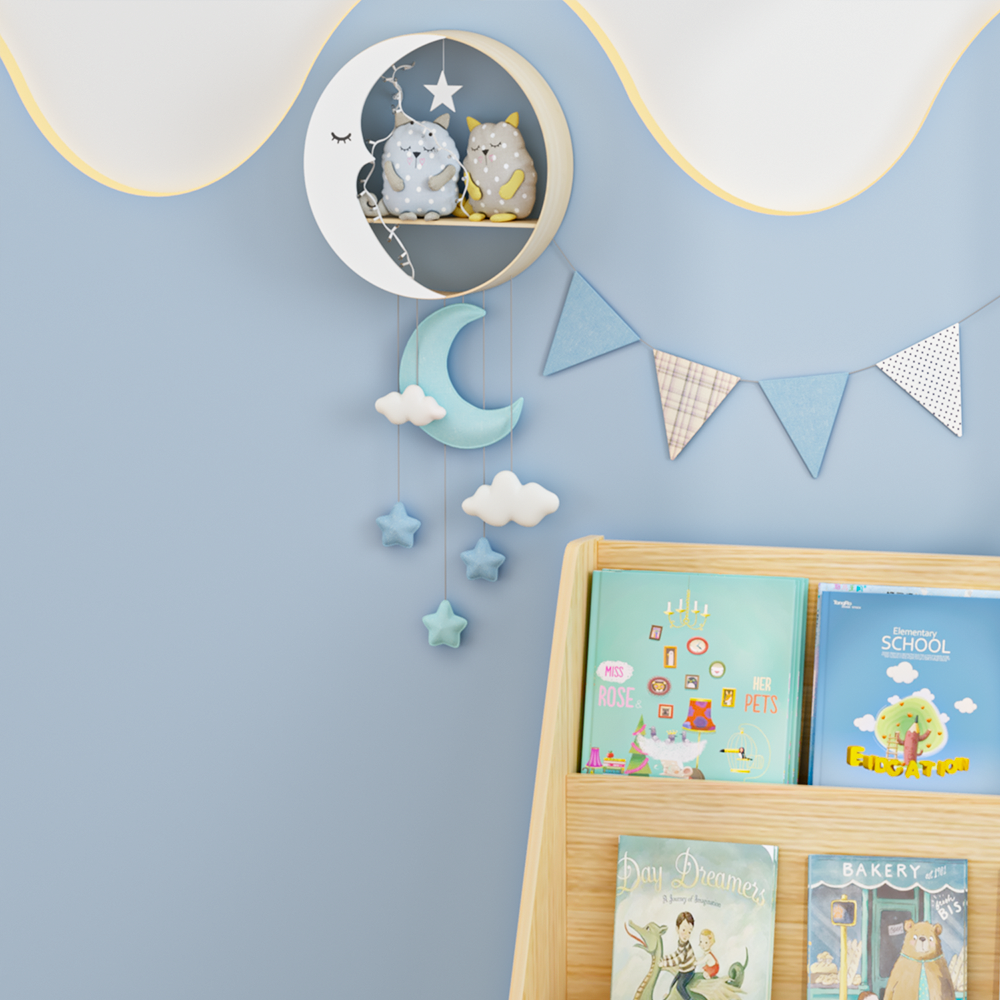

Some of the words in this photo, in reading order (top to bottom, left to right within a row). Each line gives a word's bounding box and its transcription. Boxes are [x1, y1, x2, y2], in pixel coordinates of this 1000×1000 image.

[893, 626, 938, 639] Elementary
[881, 635, 951, 654] SCHOOL
[605, 665, 624, 678] MISS
[752, 676, 772, 691] HER
[598, 685, 635, 708] ROSE
[635, 699, 643, 709] &
[744, 693, 778, 714] PETS
[616, 851, 663, 896] Day
[671, 847, 766, 907] Dreamers
[842, 862, 921, 879] BAKERY
